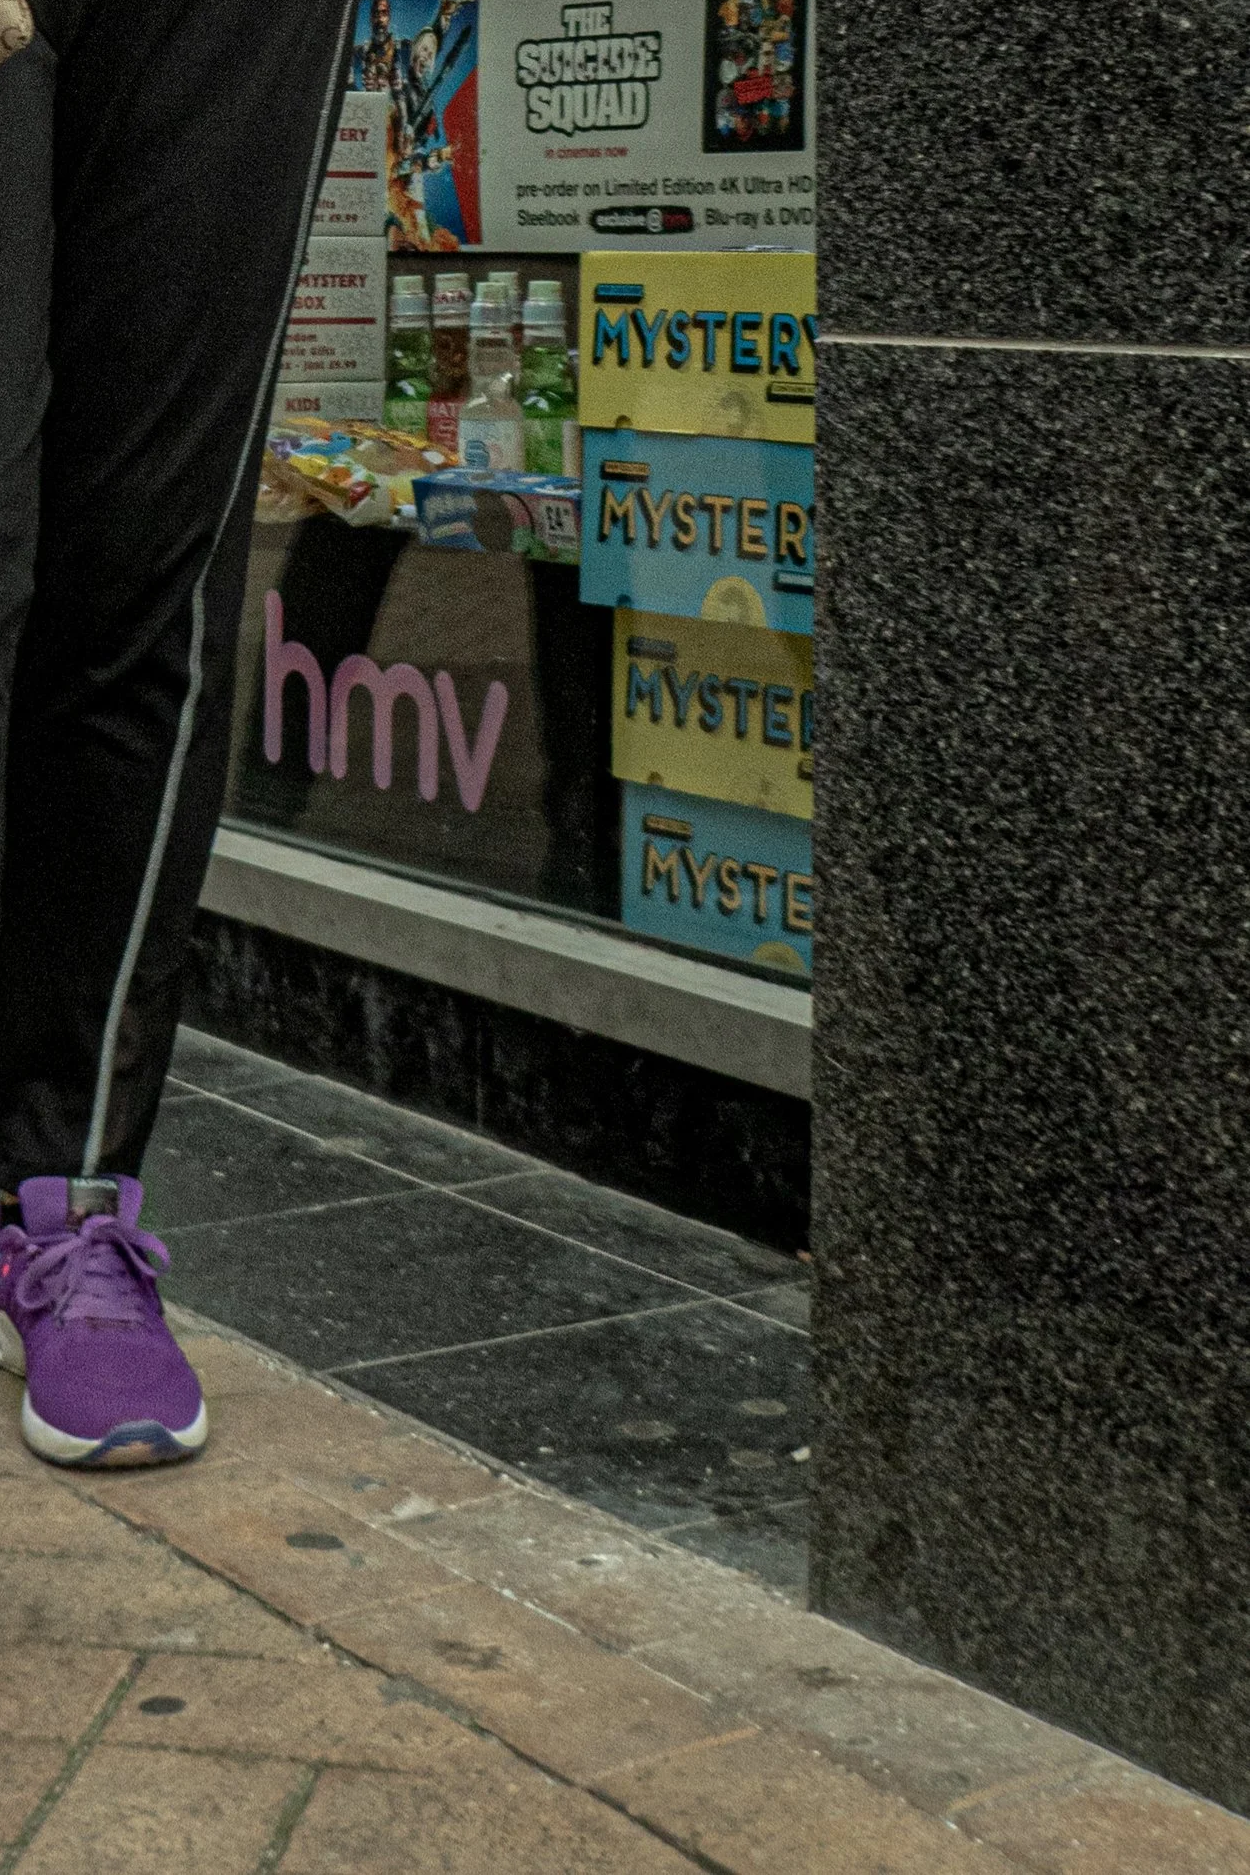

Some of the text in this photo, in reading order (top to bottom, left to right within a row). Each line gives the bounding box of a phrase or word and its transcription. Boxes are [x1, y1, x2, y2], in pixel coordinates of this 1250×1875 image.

[562, 1, 613, 38] THE
[516, 31, 662, 87] SUICIDE
[526, 80, 650, 137] SQUAD
[516, 174, 813, 201] pre-order on Limited Edition 4K Ultra HD
[517, 207, 580, 226] Steelbook
[779, 205, 814, 224] DVD
[285, 397, 322, 412] KIDS
[599, 485, 816, 565] MYSTER
[264, 589, 508, 813] hmv
